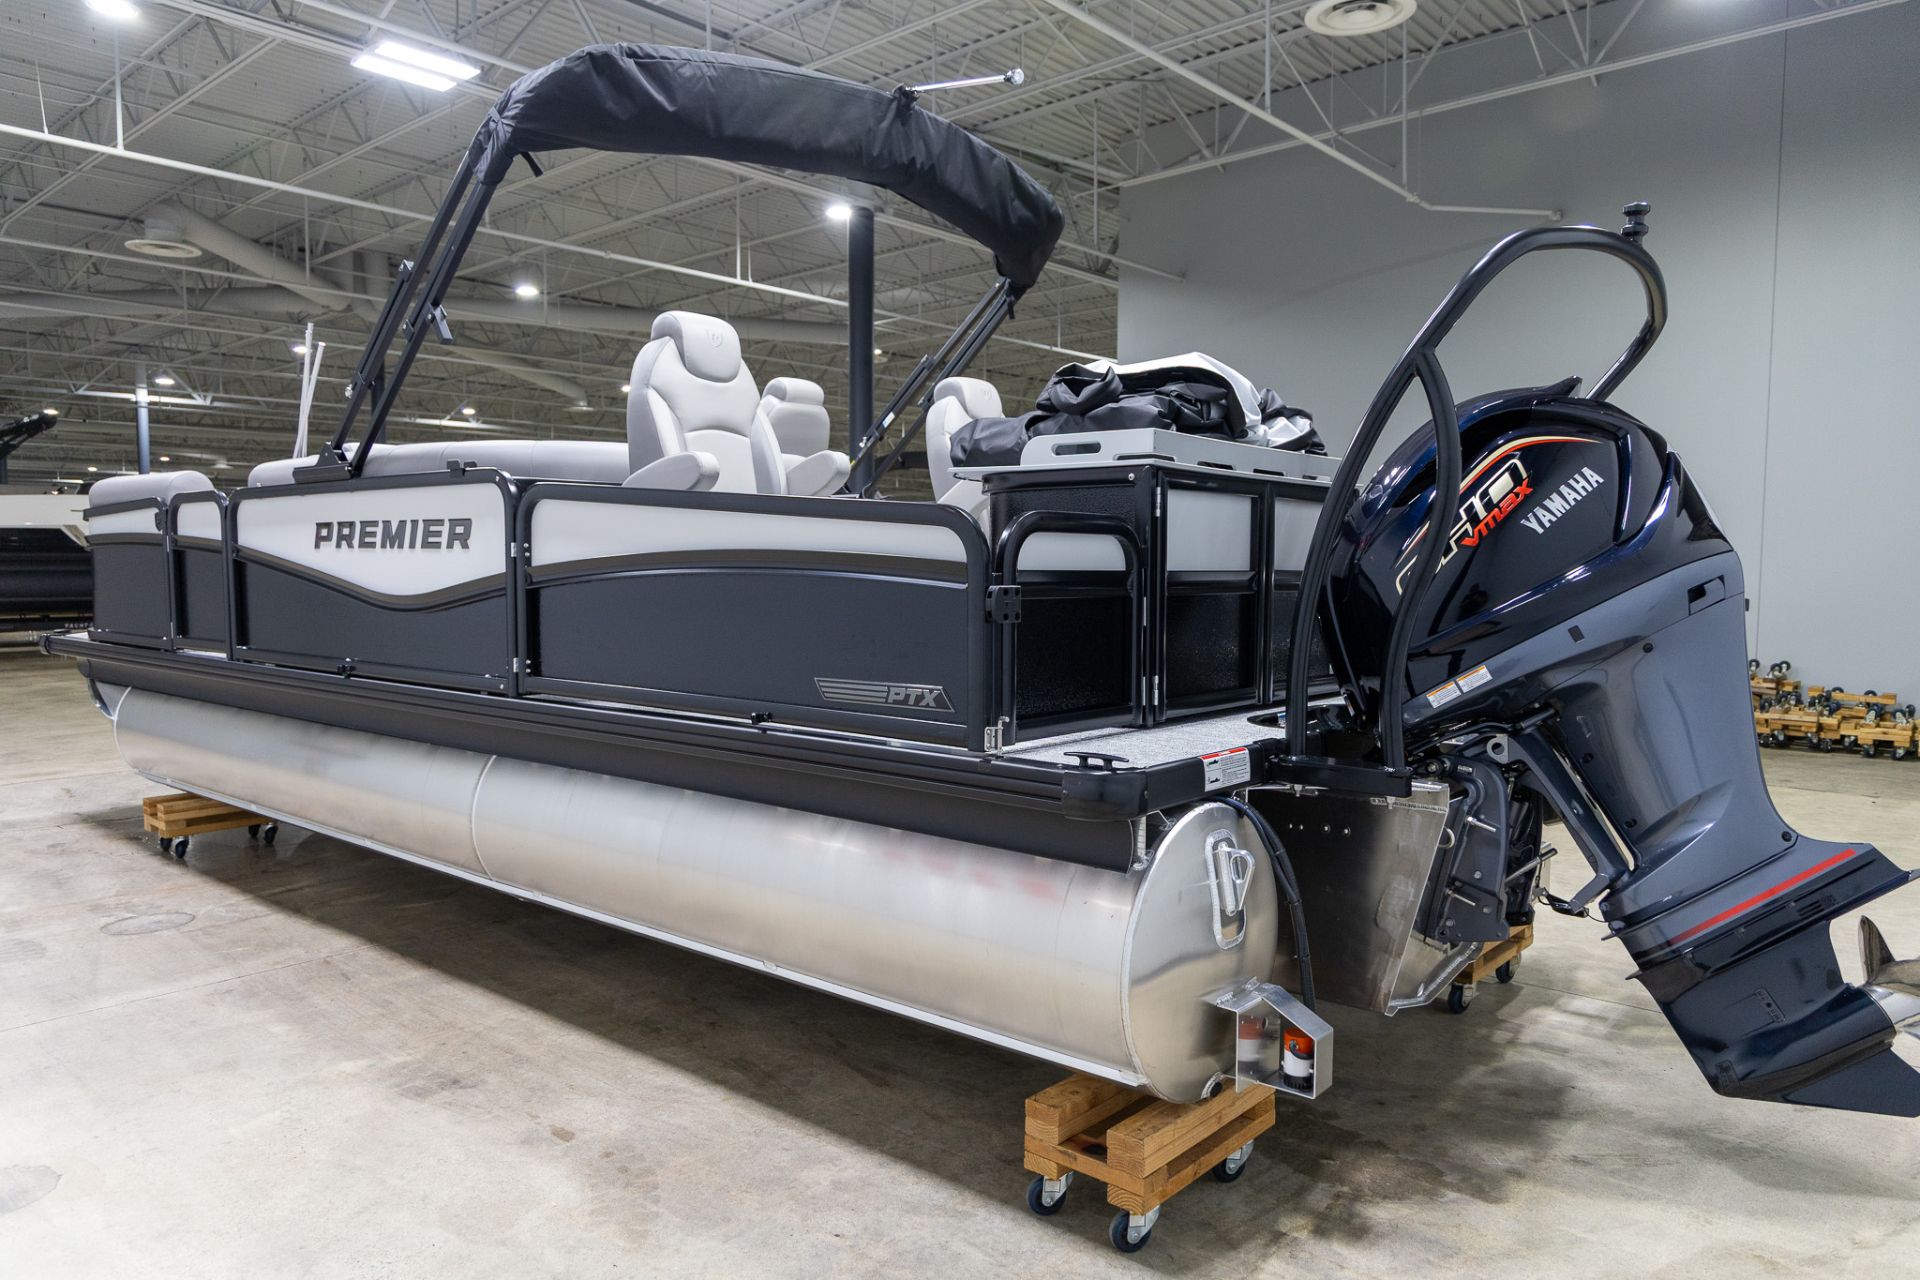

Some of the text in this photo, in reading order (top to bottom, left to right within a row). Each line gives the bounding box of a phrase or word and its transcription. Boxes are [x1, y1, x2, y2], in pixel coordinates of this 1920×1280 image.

[1520, 466, 1605, 535] YAMAHA
[314, 518, 472, 550] PREMIER
[887, 686, 941, 708] PTX
